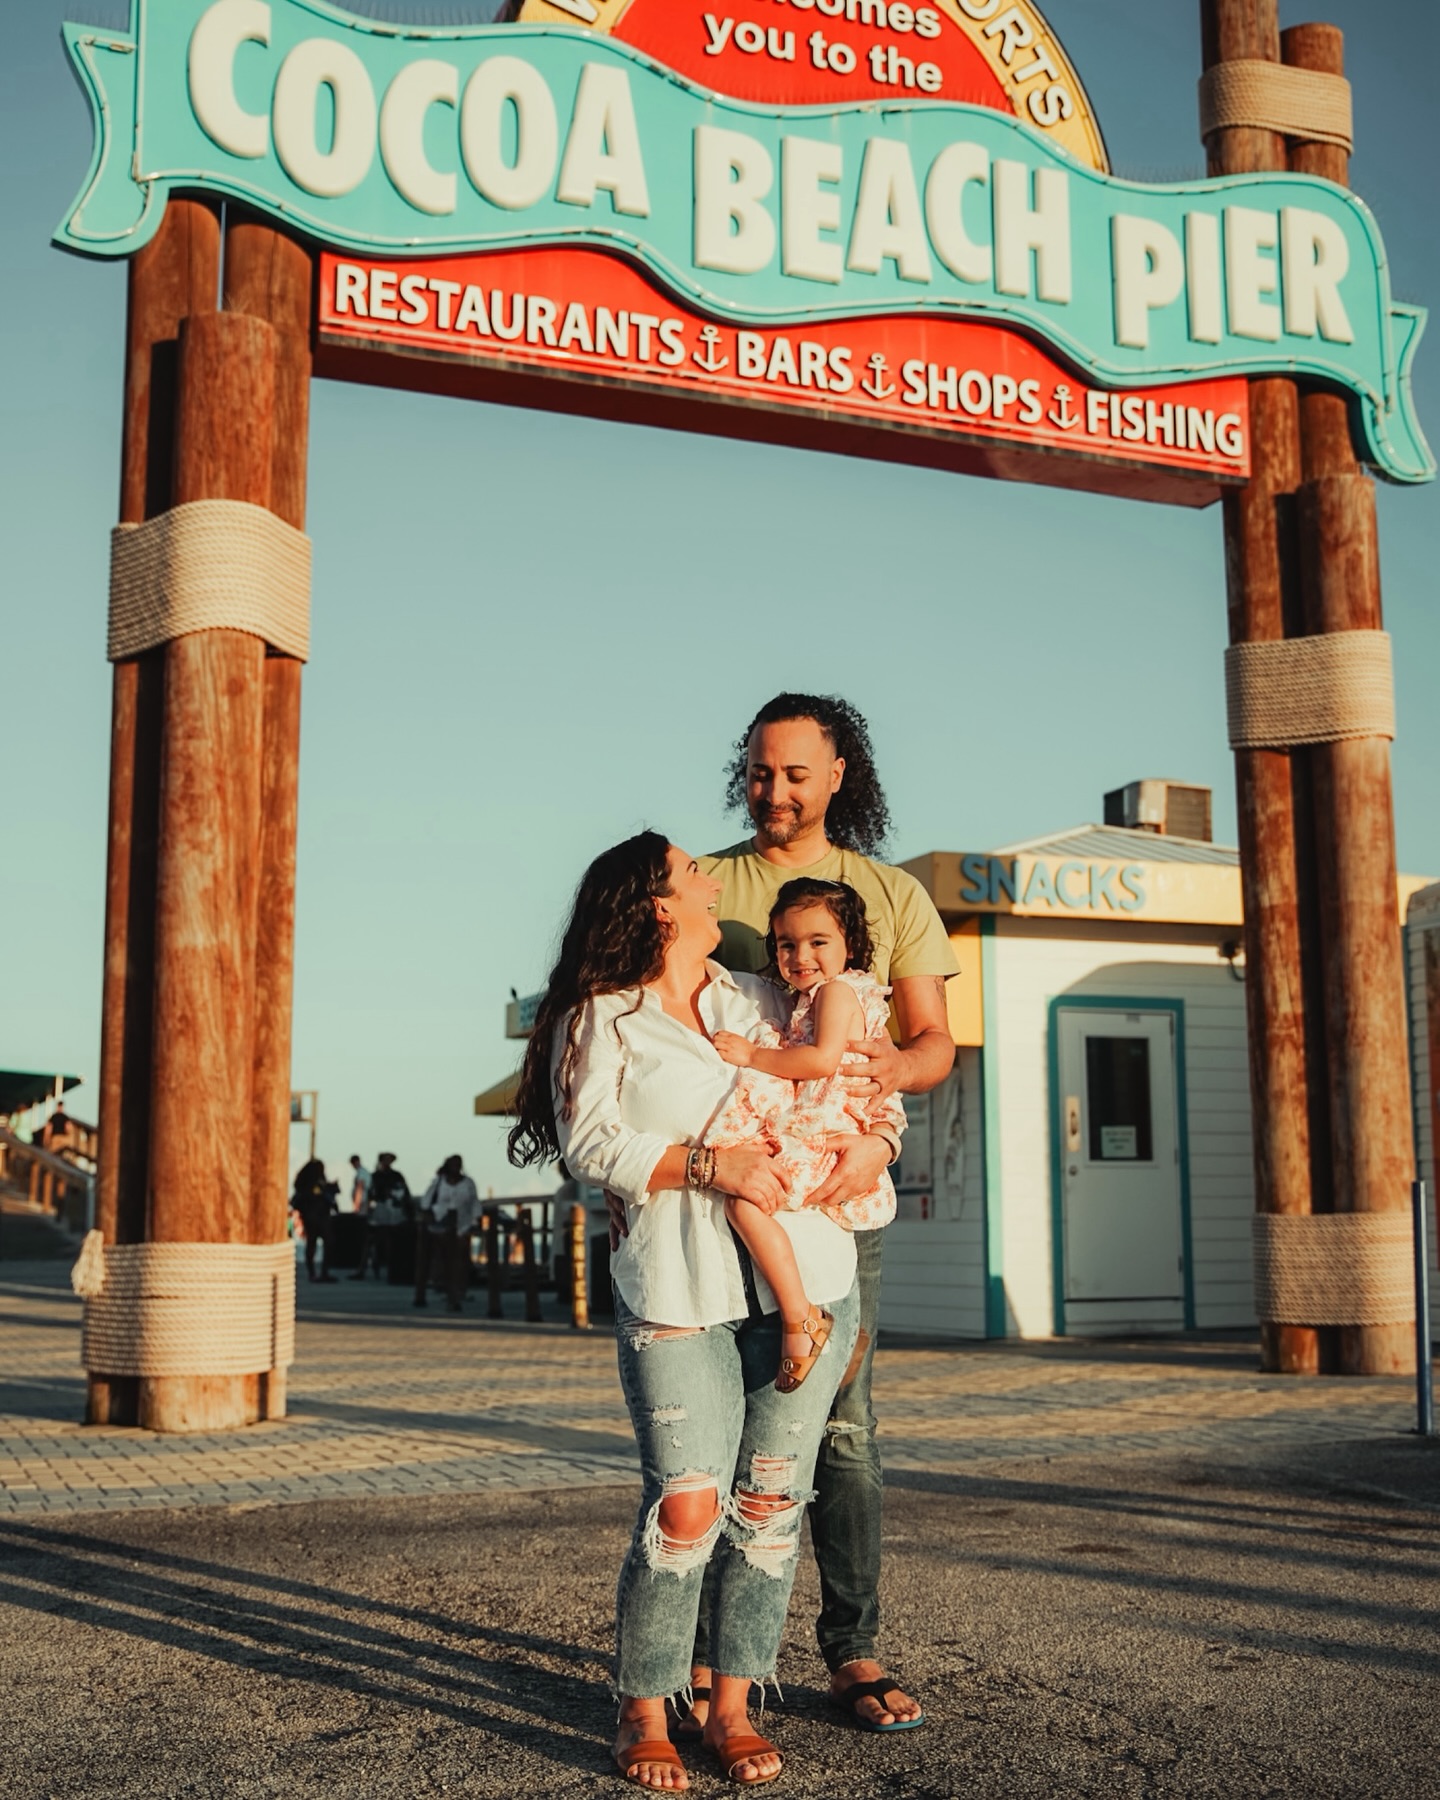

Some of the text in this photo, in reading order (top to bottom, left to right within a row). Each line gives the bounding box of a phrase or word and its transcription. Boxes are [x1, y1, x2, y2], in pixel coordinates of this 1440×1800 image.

[703, 12, 943, 92] you to the
[189, 0, 1355, 349] COCOA BEACH PIER
[335, 264, 1244, 457] RESTAURANTS BARS SHOPS FISHING
[960, 853, 1146, 911] SNACKS
